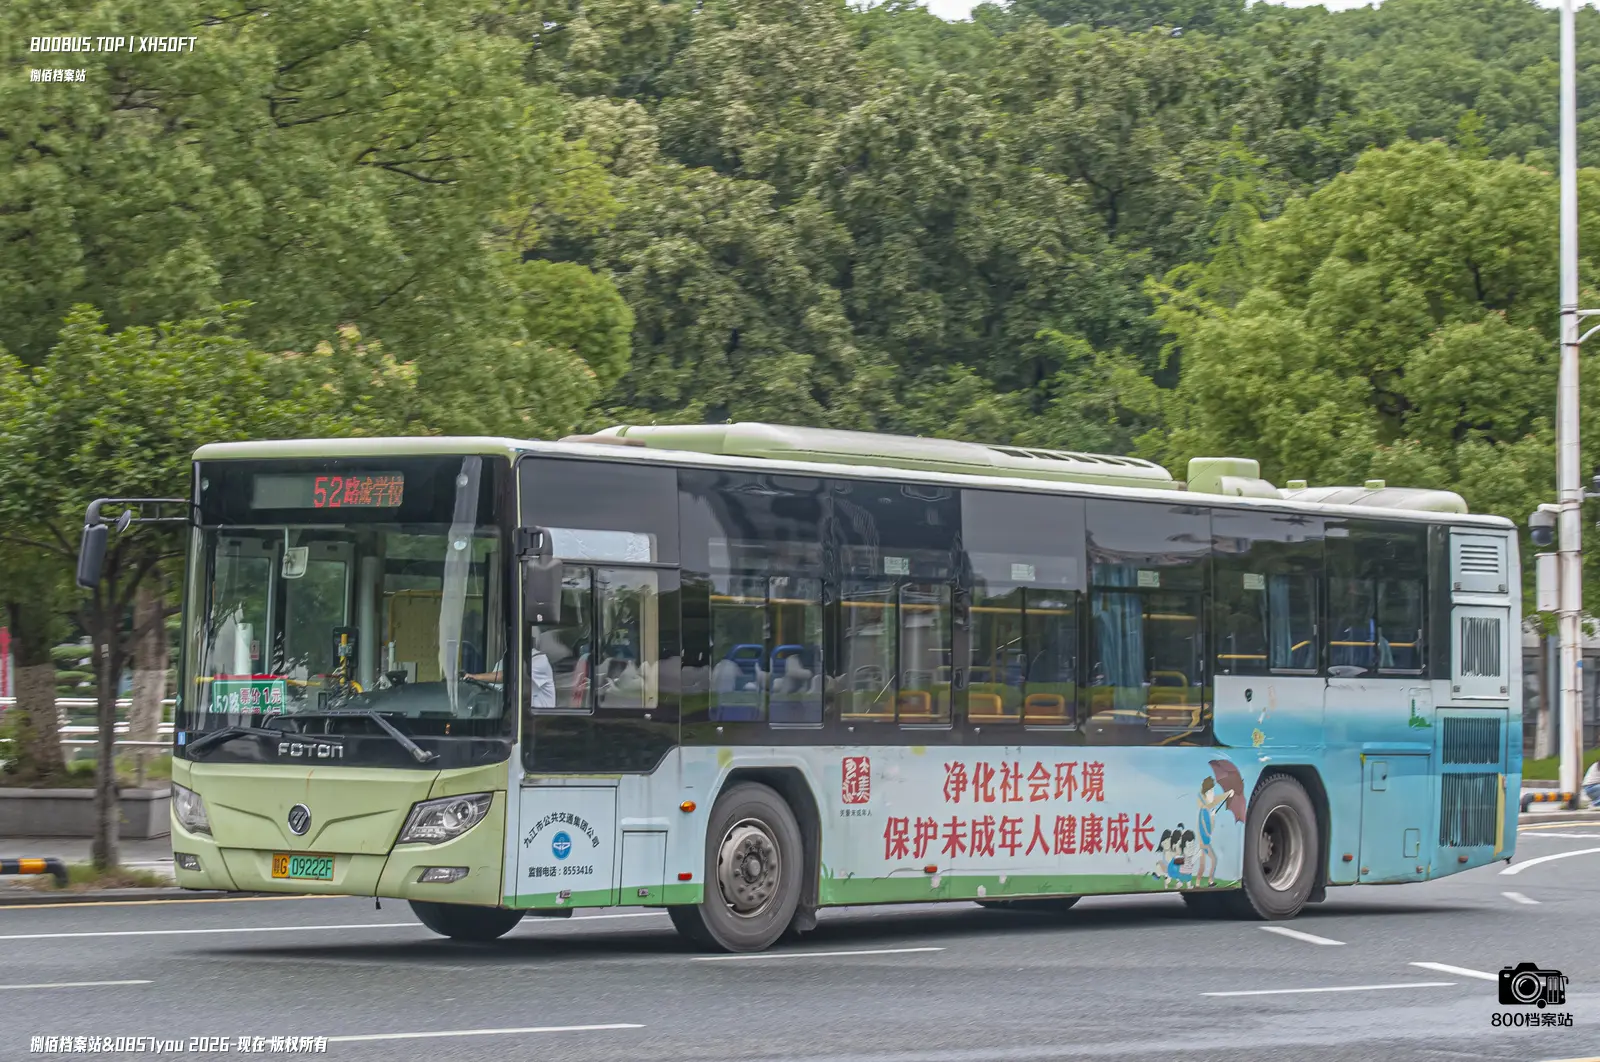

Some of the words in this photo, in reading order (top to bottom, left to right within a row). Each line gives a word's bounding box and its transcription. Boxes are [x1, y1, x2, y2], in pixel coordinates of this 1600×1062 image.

[278, 742, 344, 758] FOTON
[943, 760, 1105, 804] 净化社会环境
[523, 812, 600, 848] 九江市公共交通集团公司
[883, 812, 1155, 860] 保护未成年人健康成长
[292, 858, 333, 876] 09222F
